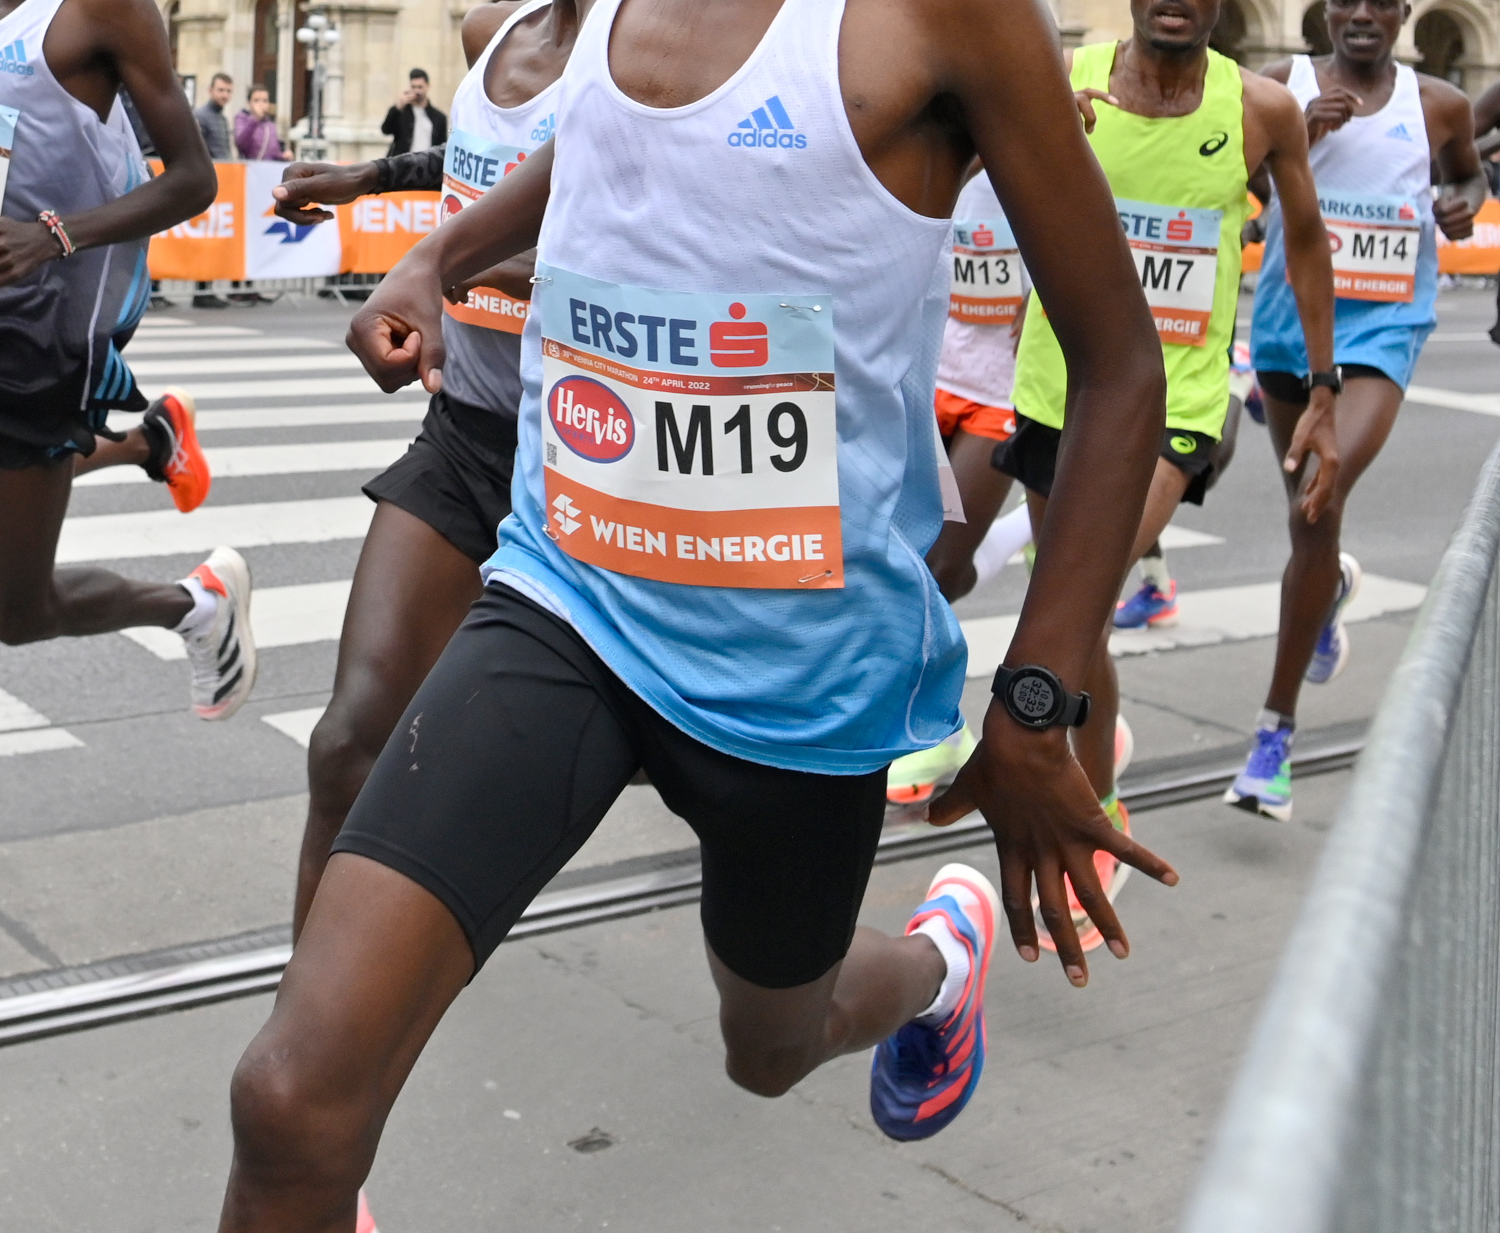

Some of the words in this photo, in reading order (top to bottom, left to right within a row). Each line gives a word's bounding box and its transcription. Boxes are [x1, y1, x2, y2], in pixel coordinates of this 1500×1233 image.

[727, 128, 807, 149] adidas
[453, 145, 499, 187] ERSTE
[1352, 233, 1408, 260] M14
[954, 257, 1010, 285] M13
[1142, 255, 1194, 292] M7
[569, 297, 699, 367] ERSTE
[573, 354, 594, 367] VIENNA
[594, 361, 606, 371] CITY
[606, 365, 639, 382] MARATHON
[661, 378, 686, 389] APRIL
[687, 381, 711, 390] 2022
[556, 386, 627, 445] Hervis
[654, 400, 809, 476] M19
[589, 515, 667, 557] WIEN
[675, 533, 824, 563] ENERGIE
[1024, 679, 1042, 713] 32:32
